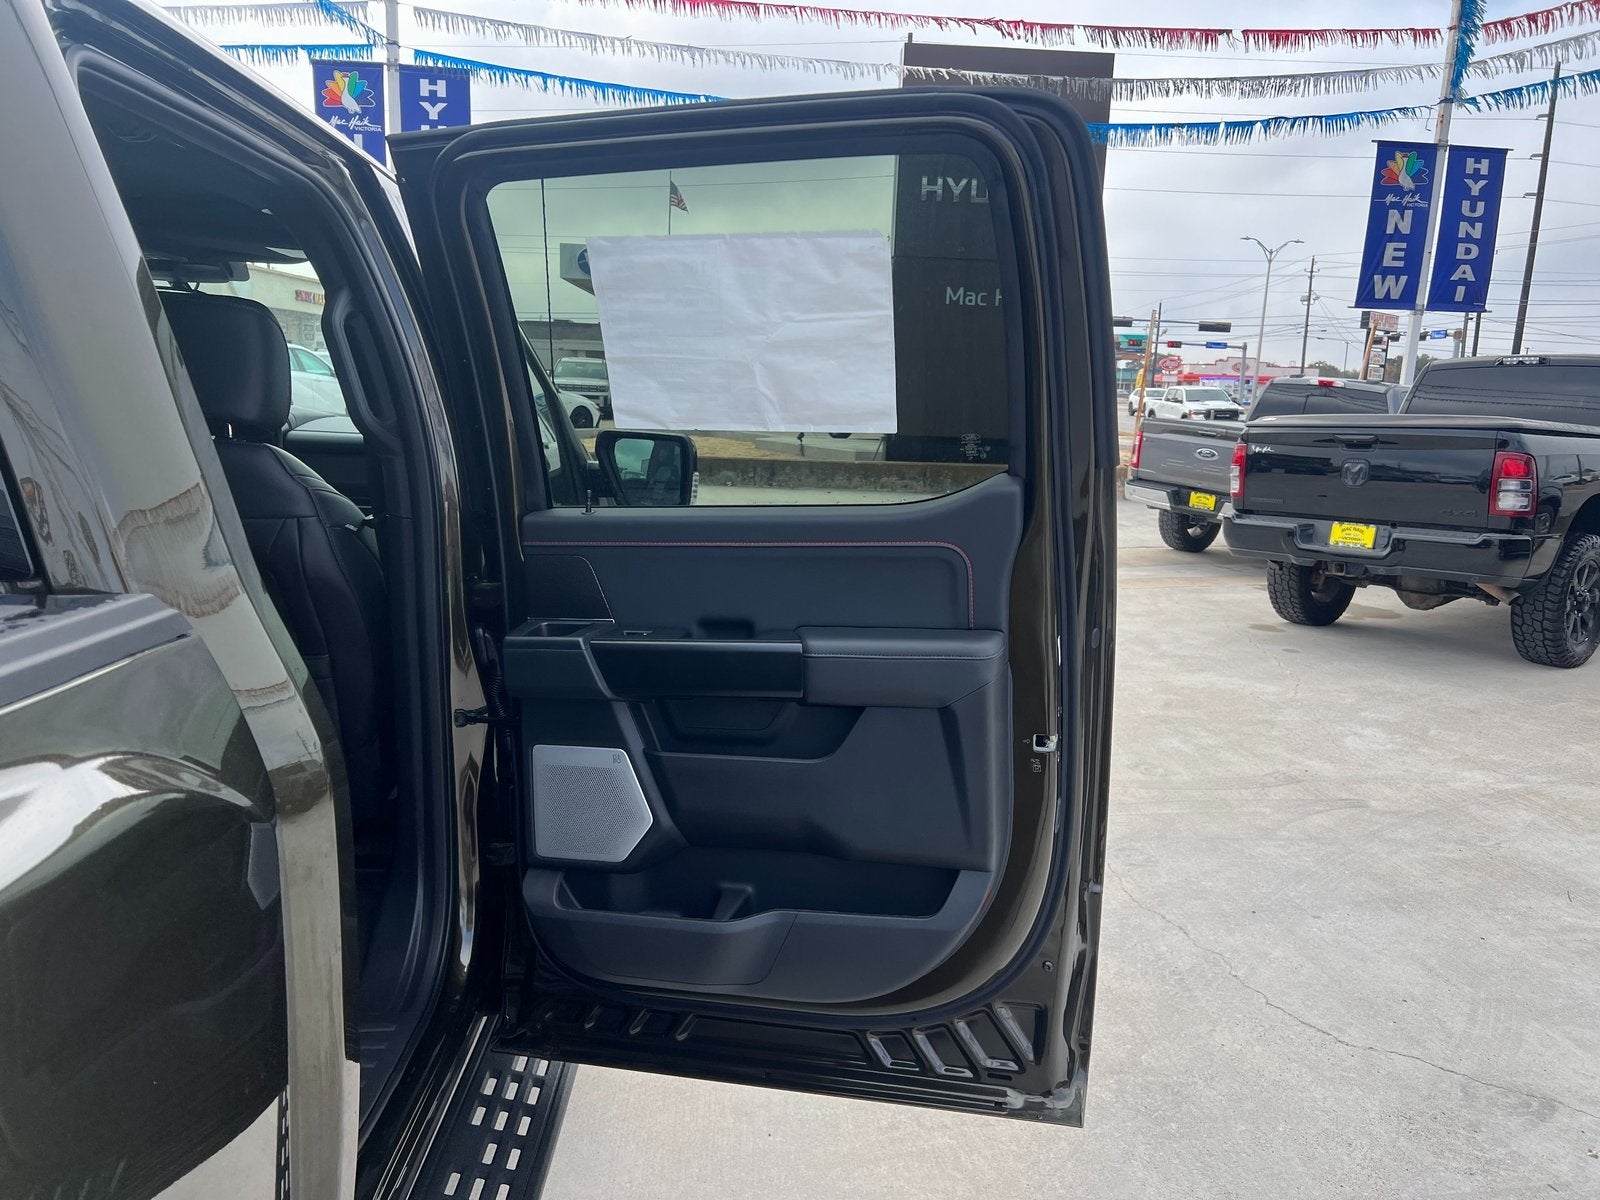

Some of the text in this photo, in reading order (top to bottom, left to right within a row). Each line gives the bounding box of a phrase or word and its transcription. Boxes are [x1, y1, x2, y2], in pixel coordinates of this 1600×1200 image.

[328, 115, 381, 129] Mac Haik
[1379, 193, 1402, 206] Mac
[1450, 157, 1490, 302] HYUNDAI
[1374, 209, 1413, 300] NEW
[945, 286, 988, 306] Mac
